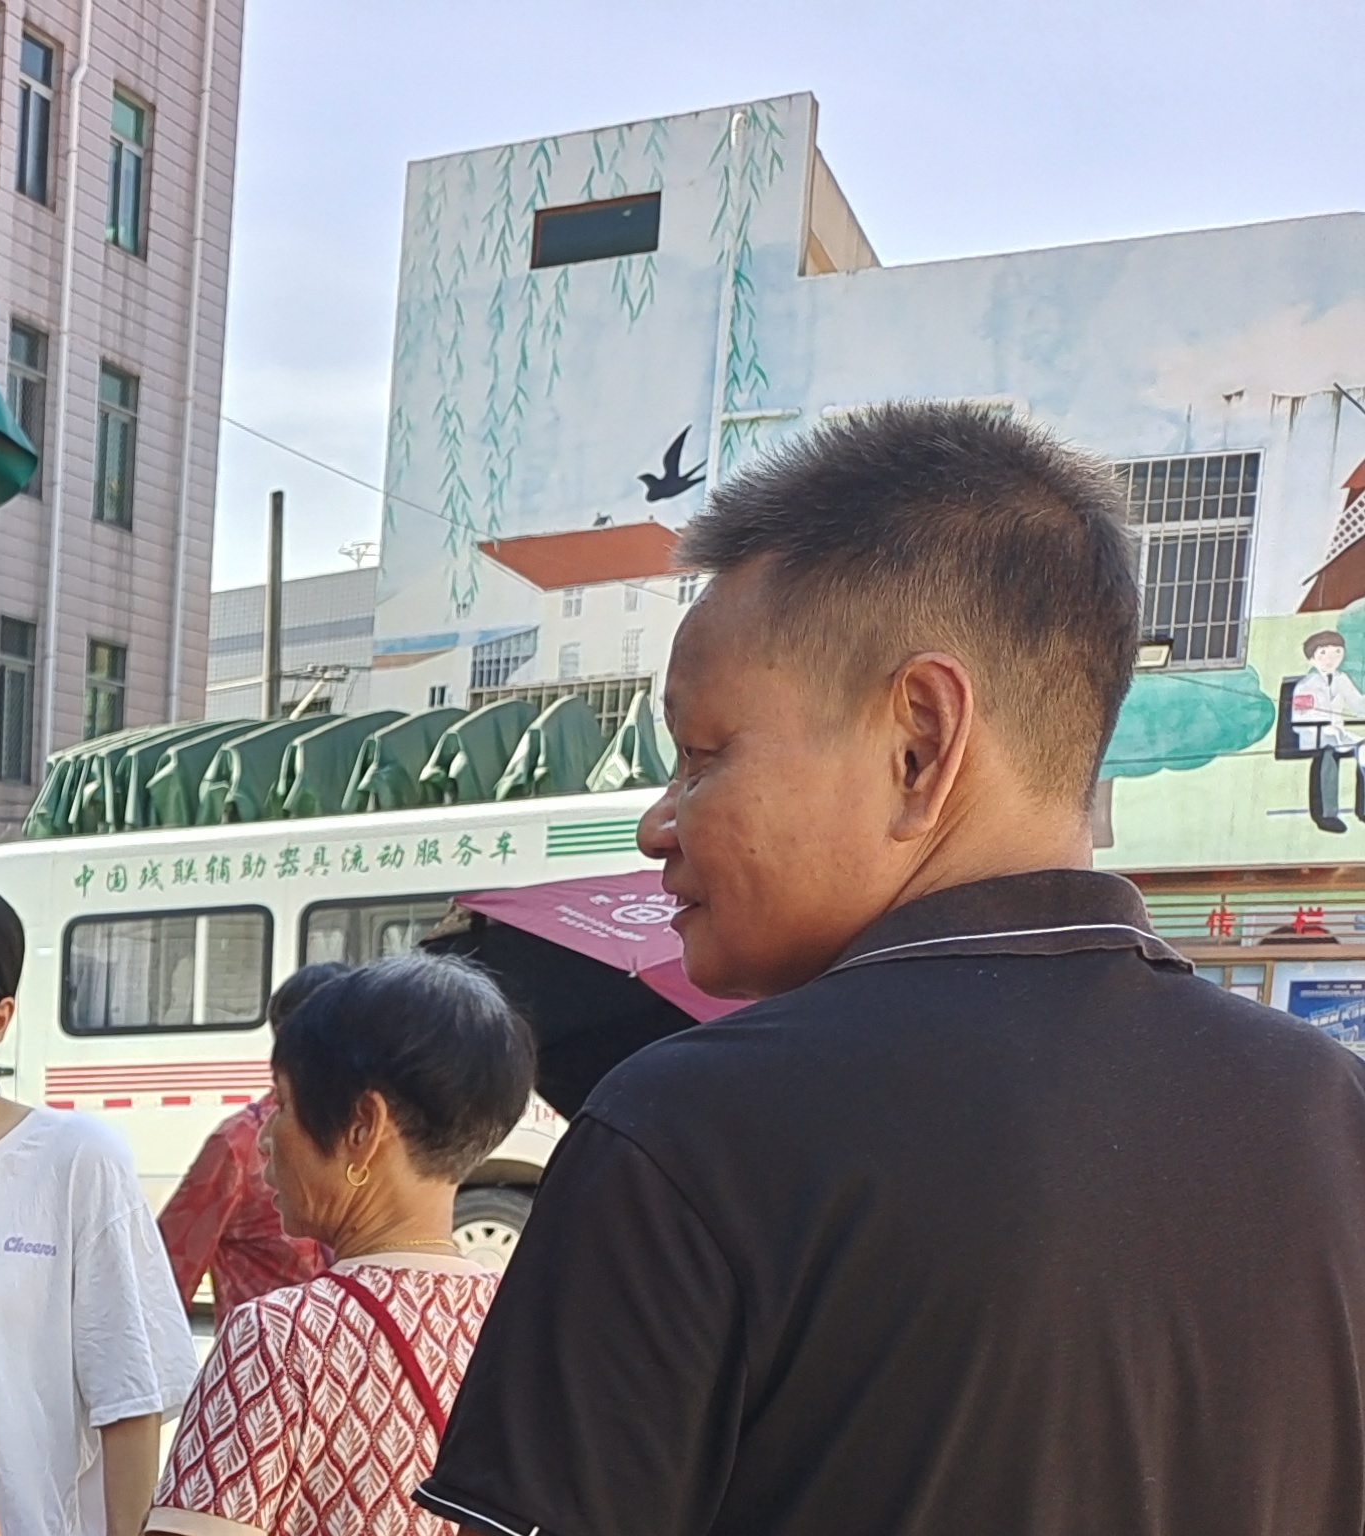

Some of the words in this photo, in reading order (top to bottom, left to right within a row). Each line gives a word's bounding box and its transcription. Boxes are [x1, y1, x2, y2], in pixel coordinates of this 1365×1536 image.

[73, 832, 518, 898] 中国残联辅助器具流动服务车
